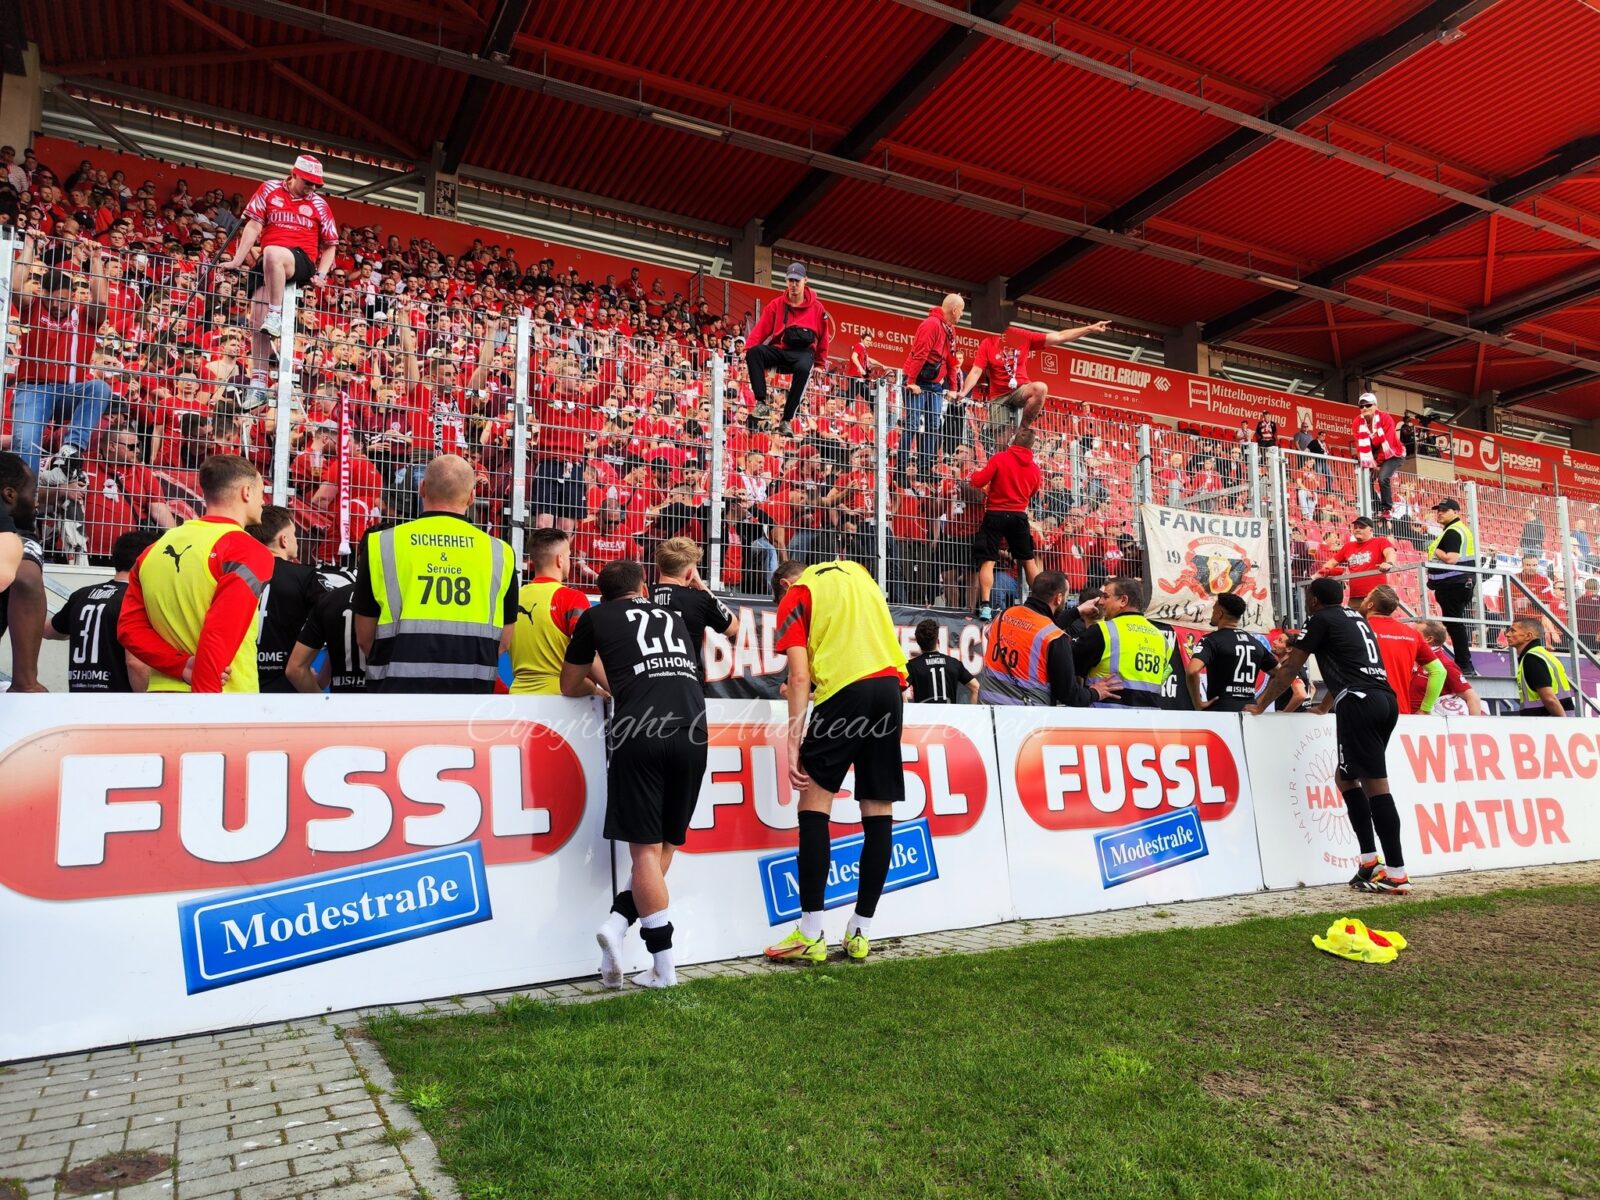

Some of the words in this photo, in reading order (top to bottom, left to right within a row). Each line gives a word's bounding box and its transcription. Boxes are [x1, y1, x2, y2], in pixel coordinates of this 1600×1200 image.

[840, 322, 875, 338] STERN
[886, 331, 915, 345] CENT
[1070, 358, 1151, 388] LEDERER.GROUP
[1211, 384, 1292, 409] Mittelbayerische
[1211, 401, 1287, 427] Plakatwerung
[1159, 510, 1261, 538] FANCLUB
[410, 533, 475, 548] SICHERHEIT
[440, 552, 448, 561] &
[427, 563, 462, 575] Service
[417, 575, 471, 606] 708
[73, 603, 106, 664] 31
[625, 608, 687, 656] 22
[1356, 620, 1378, 664] 6
[1134, 652, 1161, 674] 658
[1233, 645, 1257, 683] 25
[930, 667, 947, 701] 11
[1400, 733, 1506, 783] WIR
[1509, 732, 1600, 780] BAC
[1041, 743, 1226, 812] FUSSL
[56, 746, 551, 867] FUSSL
[1415, 798, 1571, 855] NATUR
[1110, 825, 1194, 867] Modestraße
[1323, 852, 1349, 869] SEIT
[220, 876, 459, 954] Modestraße
